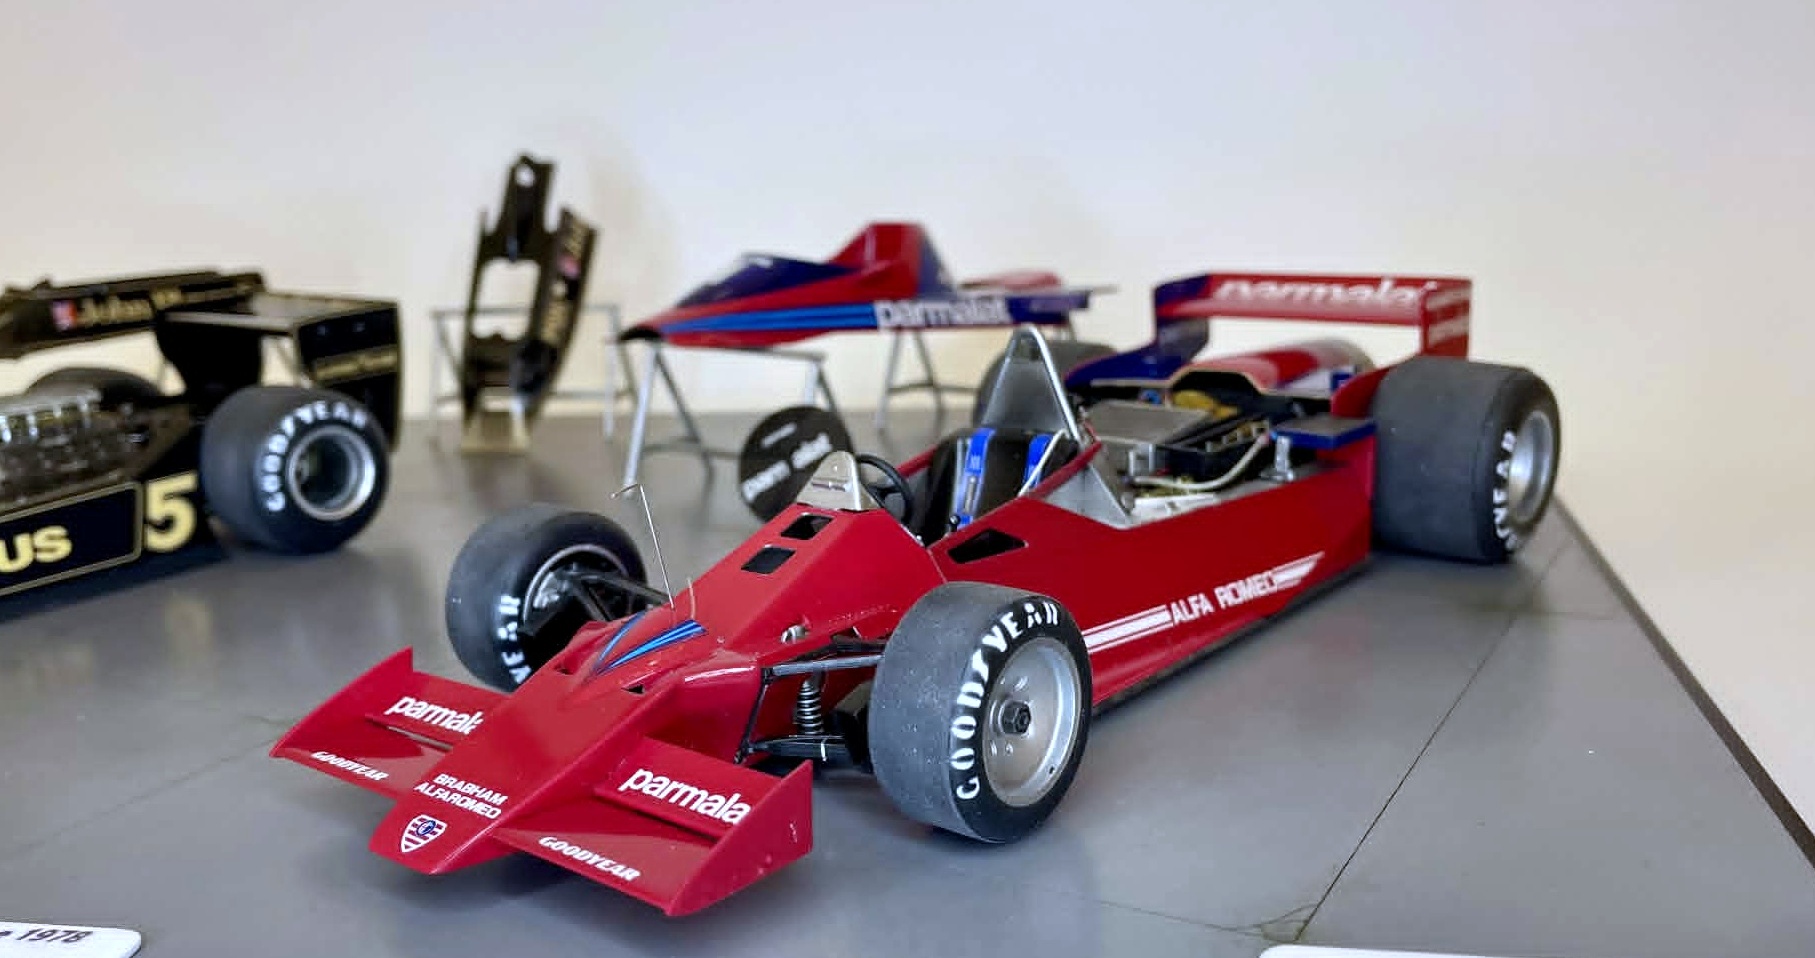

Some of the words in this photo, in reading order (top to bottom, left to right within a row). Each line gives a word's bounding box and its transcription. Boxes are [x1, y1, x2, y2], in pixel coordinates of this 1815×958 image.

[144, 471, 198, 554] 5
[1170, 592, 1215, 626] ALFA
[1213, 569, 1278, 610] ROMEO
[310, 751, 390, 781] GOODYEAR
[414, 782, 502, 820] ALFAROMEO
[433, 773, 508, 806] BRABHAM
[538, 836, 641, 881] GOODYEAR
[16, 928, 93, 943] 1978
